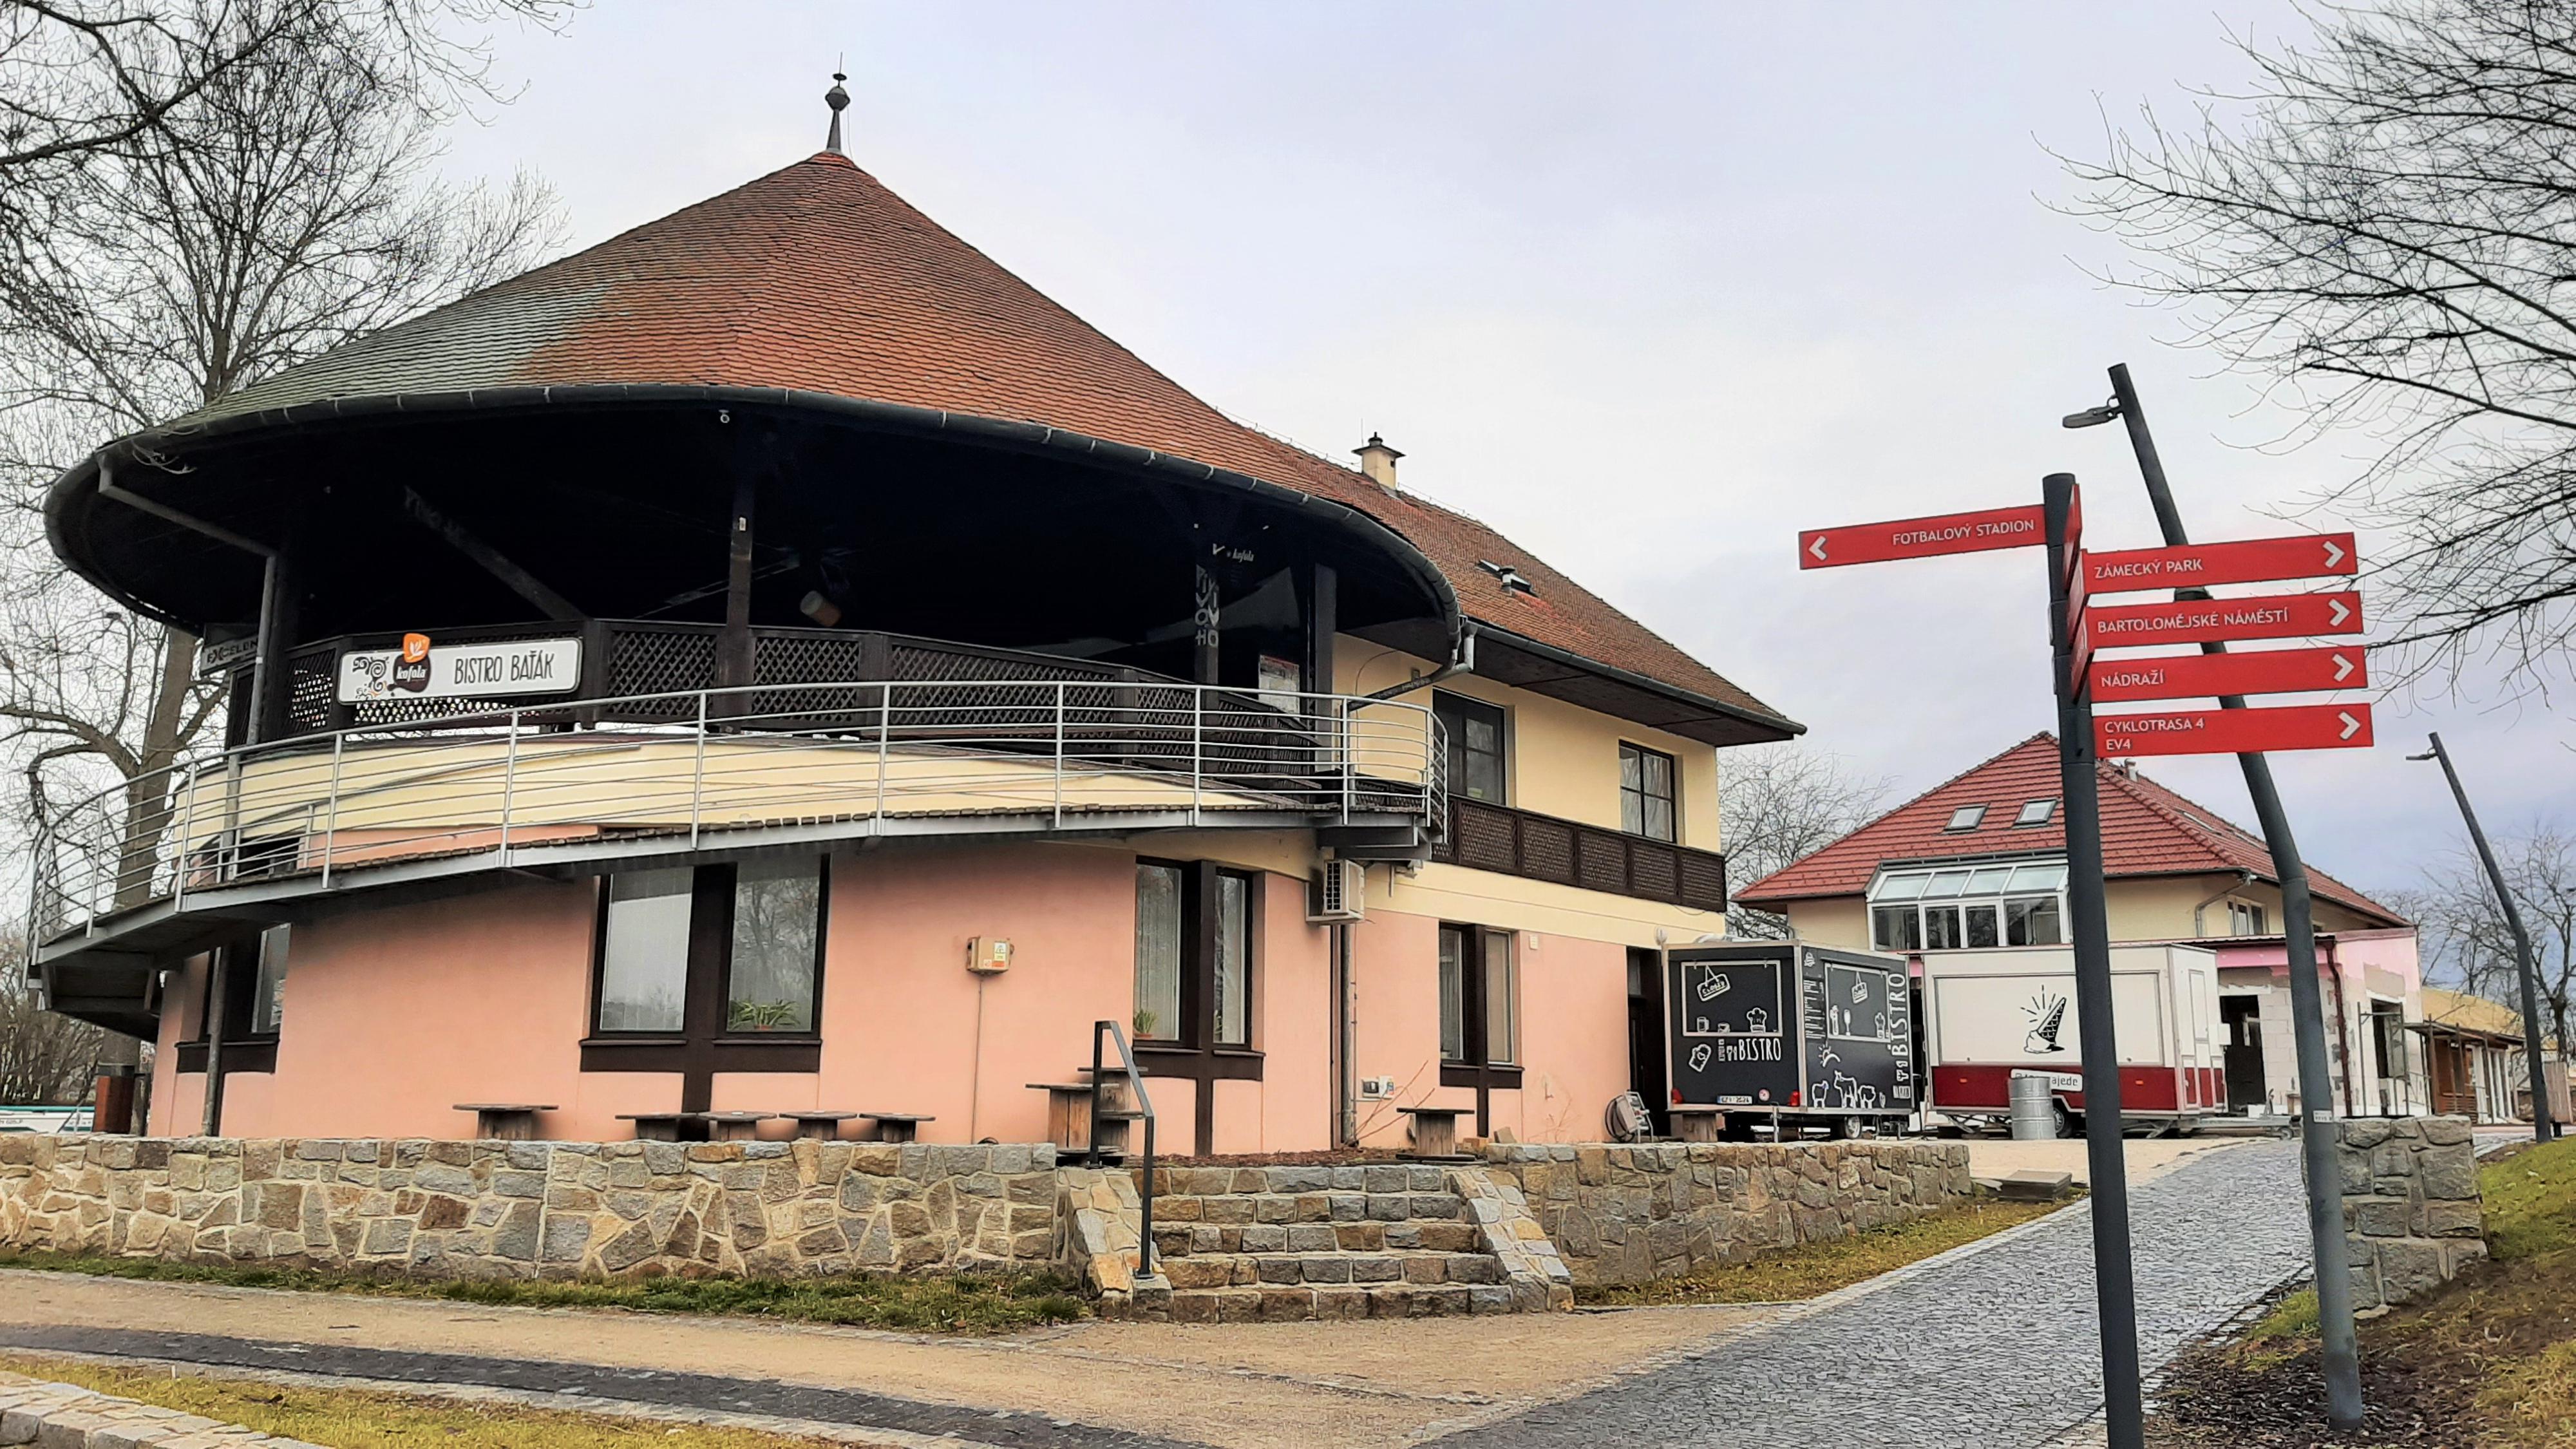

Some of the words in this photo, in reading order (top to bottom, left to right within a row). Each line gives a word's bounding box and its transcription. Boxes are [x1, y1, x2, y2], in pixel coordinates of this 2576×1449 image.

[1893, 522, 1971, 545] FOTBALOVÝ
[1975, 519, 2034, 536] STADION
[2094, 558, 2161, 579] ZÁMECKÝ
[2166, 558, 2203, 573] PARK
[396, 665, 427, 683] kofola
[454, 656, 502, 685] BISTRO
[511, 650, 554, 681] BAŤÁK
[2101, 668, 2164, 688] NÁDRAŽÍ
[2105, 718, 2192, 734] CYKLOTRASA
[2195, 717, 2205, 729] 4
[2106, 739, 2131, 751] EV4
[1888, 973, 1909, 1056] BISTRO
[1739, 1037, 1781, 1061] BISTRO
